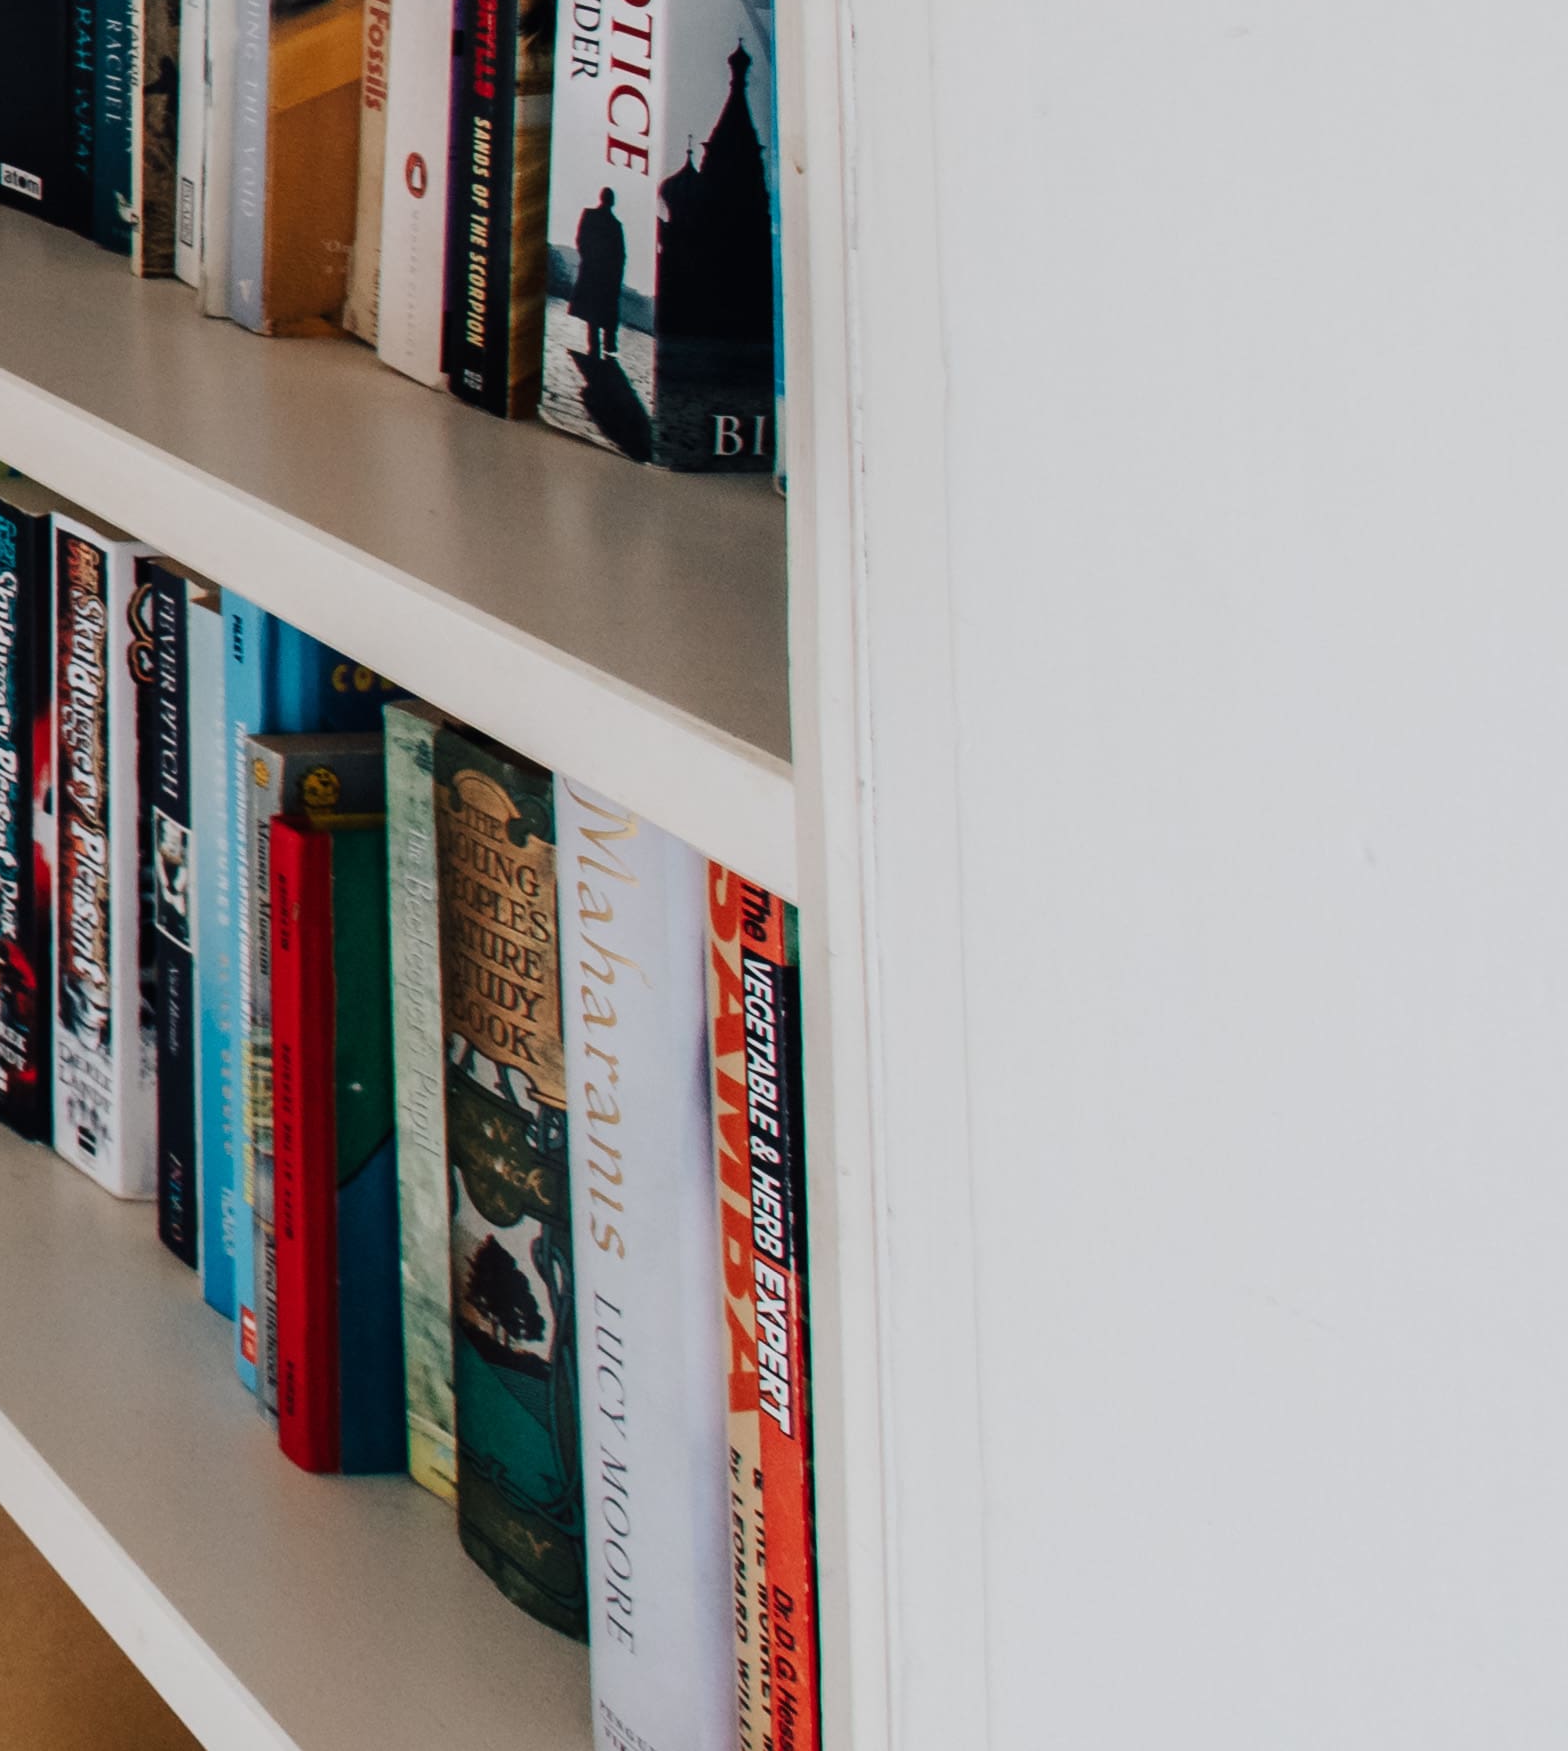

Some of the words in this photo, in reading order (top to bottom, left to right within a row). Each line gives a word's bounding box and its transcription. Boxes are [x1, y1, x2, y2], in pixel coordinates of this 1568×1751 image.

[105, 18, 123, 126] RACHEL
[243, 82, 263, 126] THE
[364, 6, 391, 114] Fossils
[2, 167, 41, 198] atom
[238, 146, 262, 220] VOID
[471, 115, 493, 177] SANDS
[468, 213, 489, 249] THE
[470, 183, 490, 209] OF
[466, 251, 489, 348] SCORPION
[158, 590, 177, 693] FEVER
[61, 597, 105, 822] Skulduggery
[159, 698, 179, 800] PITCH
[257, 819, 271, 894] Monster
[461, 803, 505, 845] THE
[71, 817, 107, 988] Pleasant
[257, 898, 272, 976] Museum
[740, 881, 770, 944] The
[563, 778, 657, 1263] Maharanis
[741, 957, 778, 1140] VEGETABLE
[402, 1074, 440, 1156] Pupil
[749, 1134, 779, 1163] &
[751, 1166, 784, 1260] HERB
[263, 1235, 276, 1293] Alfred
[264, 1296, 277, 1388] Hitchcock
[593, 1288, 628, 1440] LUCY
[753, 1258, 795, 1441] EXPERT
[600, 1446, 637, 1655] MOORE
[732, 1495, 751, 1644] LEONARD
